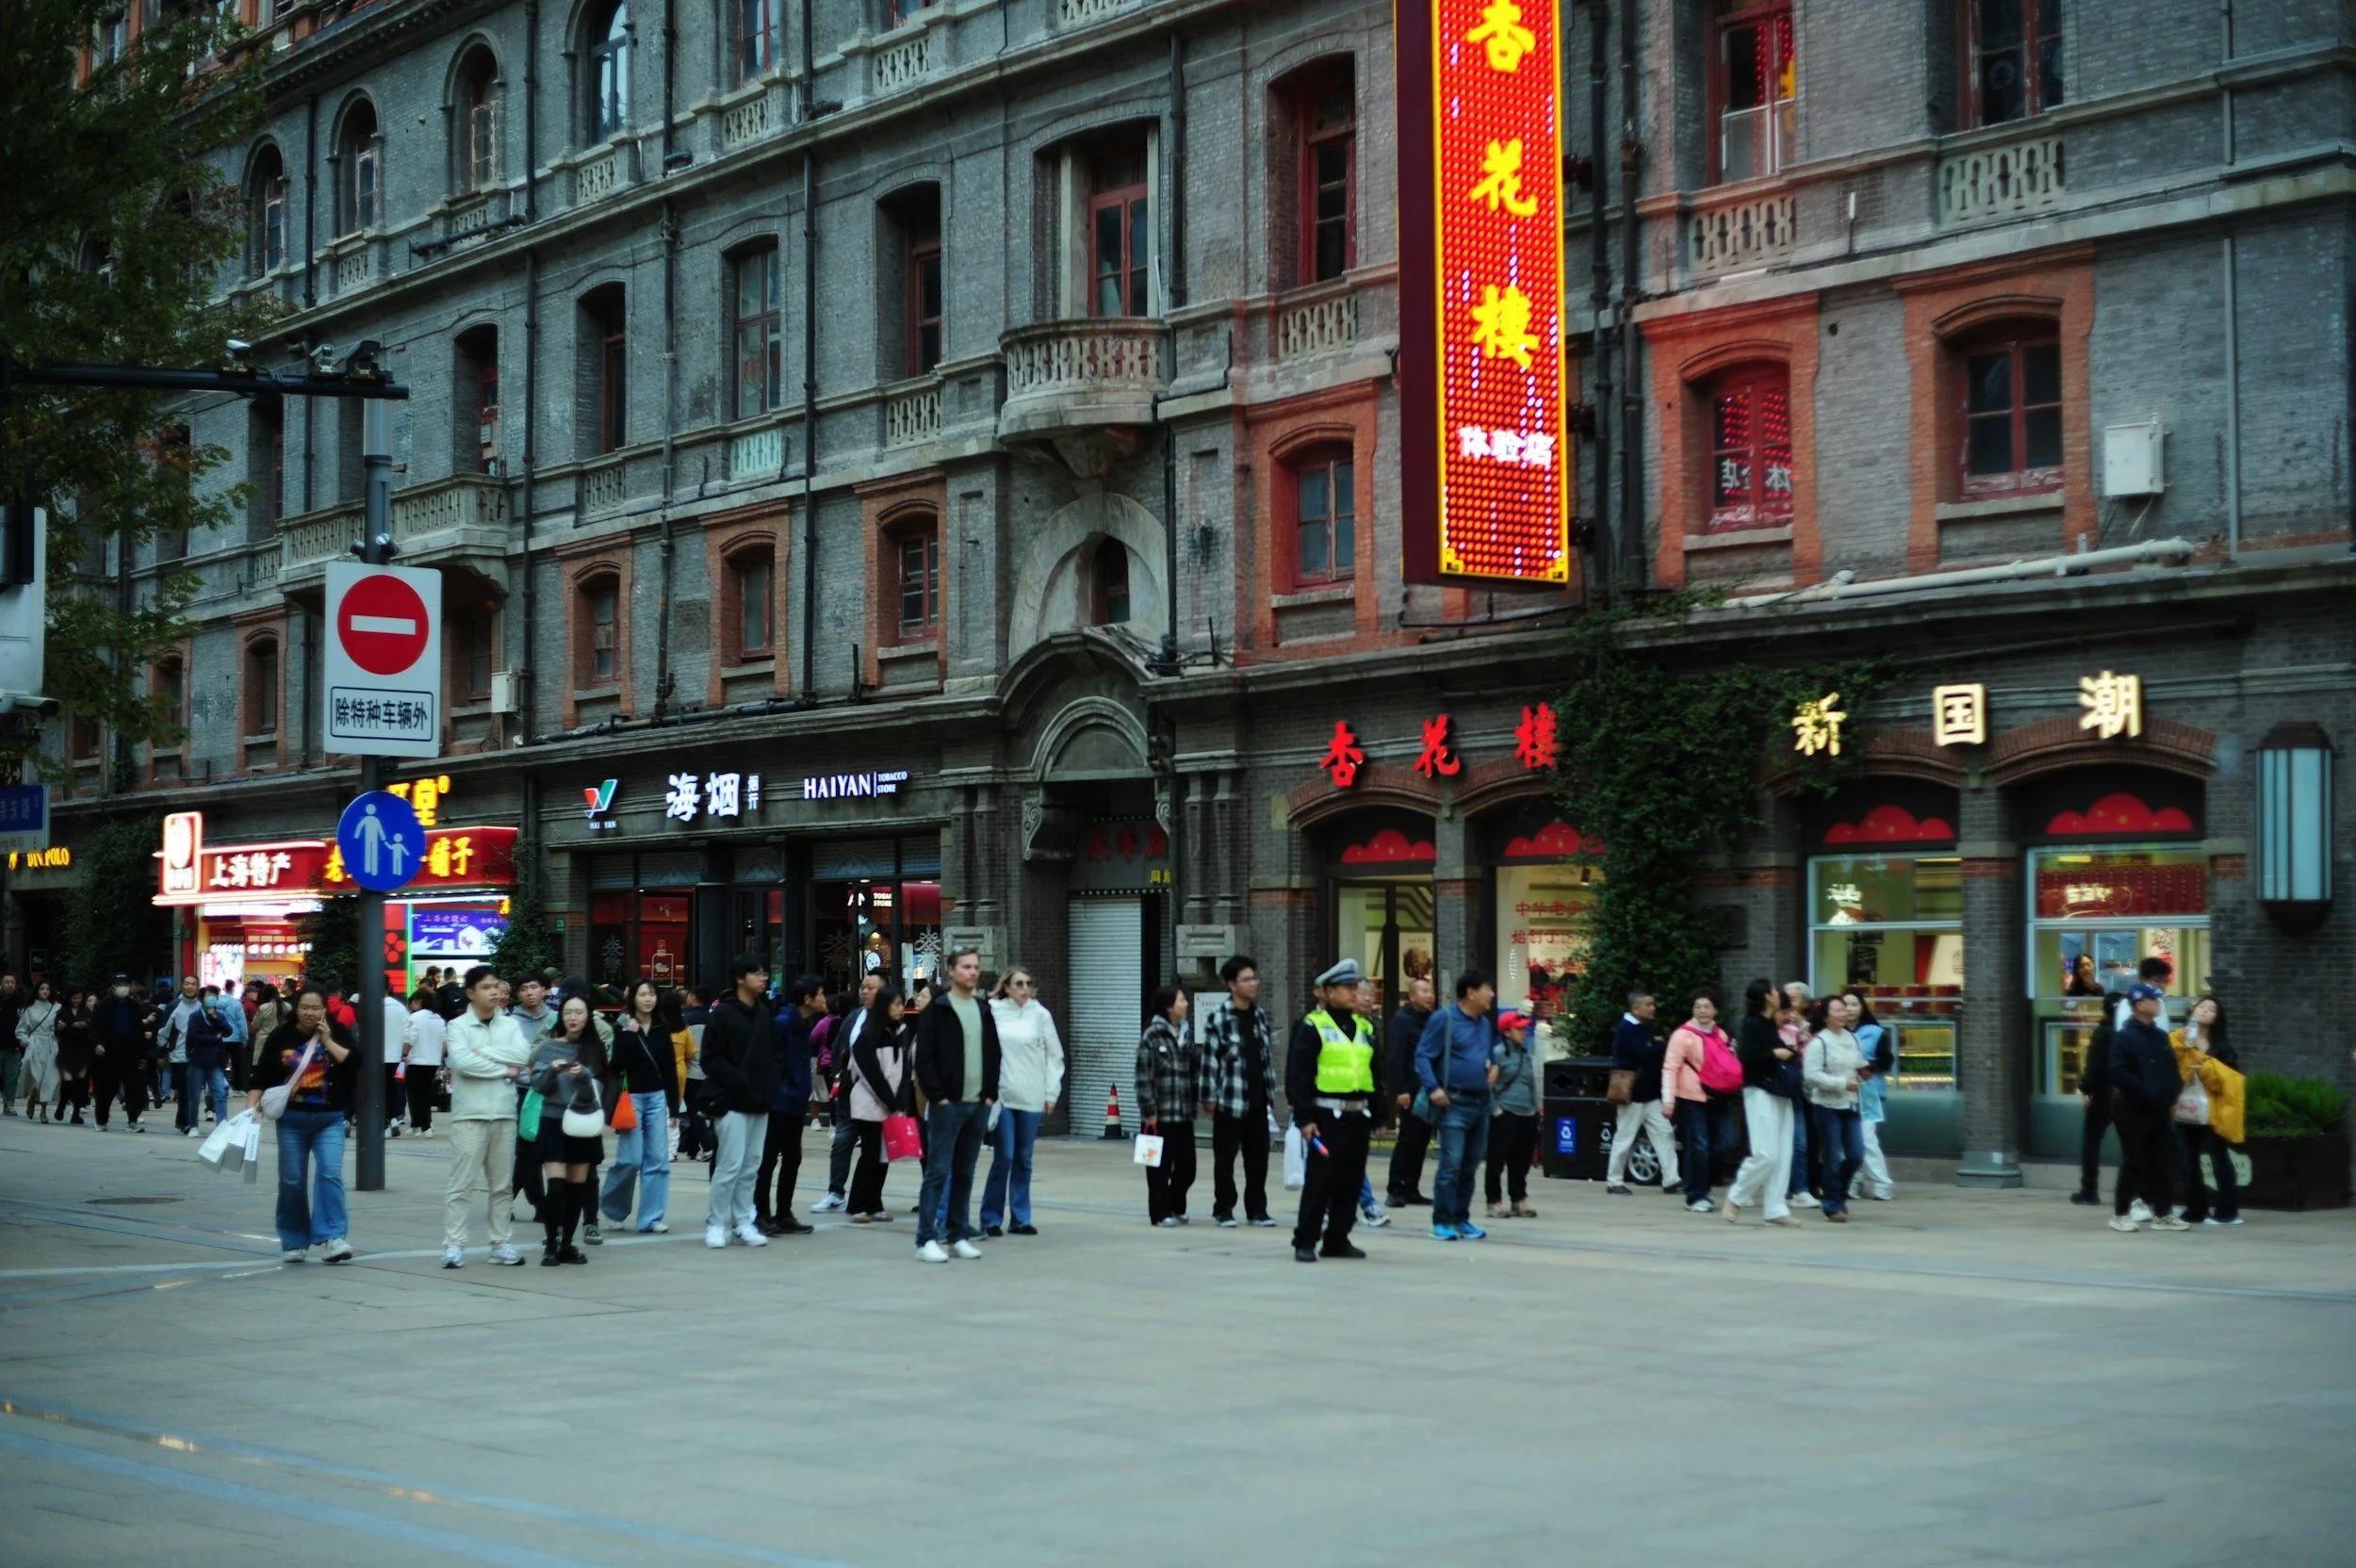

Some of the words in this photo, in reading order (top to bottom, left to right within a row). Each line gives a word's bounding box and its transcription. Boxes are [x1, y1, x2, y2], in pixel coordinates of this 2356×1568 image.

[1458, 426, 1556, 466] 体验店
[335, 696, 428, 731] 除特种车辆外
[1792, 670, 2141, 757] 新国潮
[804, 774, 872, 799] HAIYAN
[876, 784, 897, 793] STORE
[877, 771, 908, 782] TOBACCO
[665, 772, 741, 823] 海烟
[604, 821, 617, 829] YAN
[209, 851, 291, 888] 上海特产
